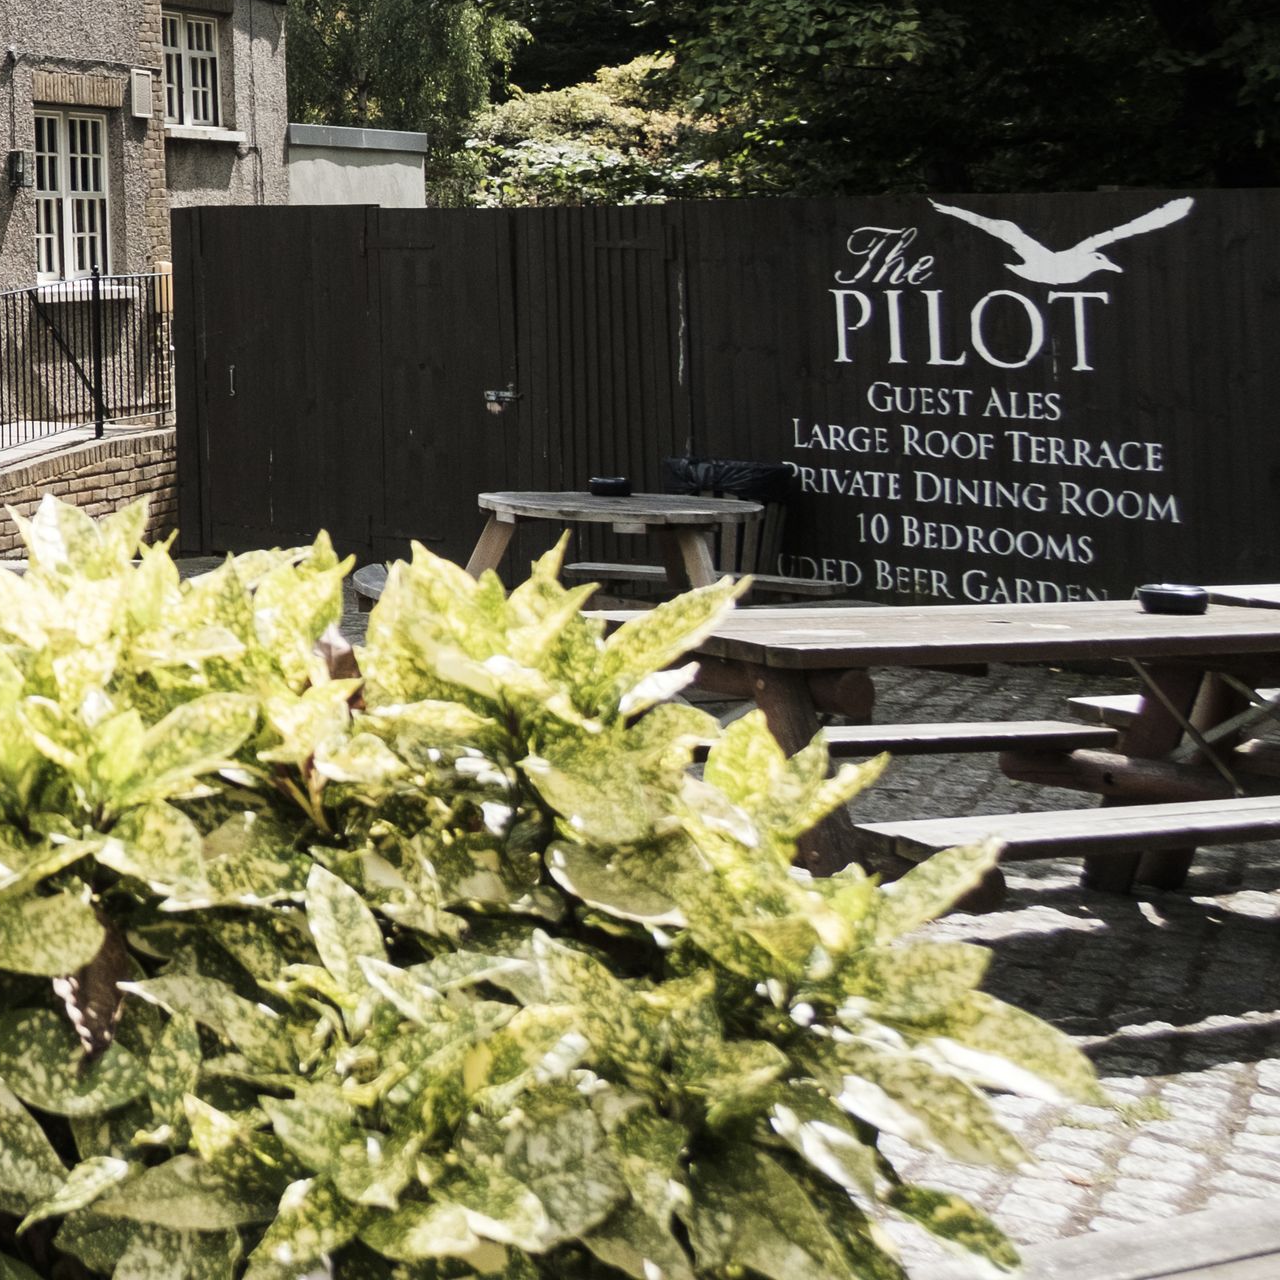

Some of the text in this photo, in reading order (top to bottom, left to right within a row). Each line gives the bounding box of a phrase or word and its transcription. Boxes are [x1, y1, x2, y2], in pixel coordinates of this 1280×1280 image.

[834, 225, 936, 286] The
[828, 288, 1110, 372] PILOT
[867, 380, 1062, 421] GUEST ALES
[792, 417, 1164, 472] LARGE ROOF TERRACE
[914, 470, 1048, 513] DINING
[1059, 481, 1182, 524] ROOM
[856, 512, 1095, 565] 10 BEDROOMS
[875, 559, 951, 600] BEER
